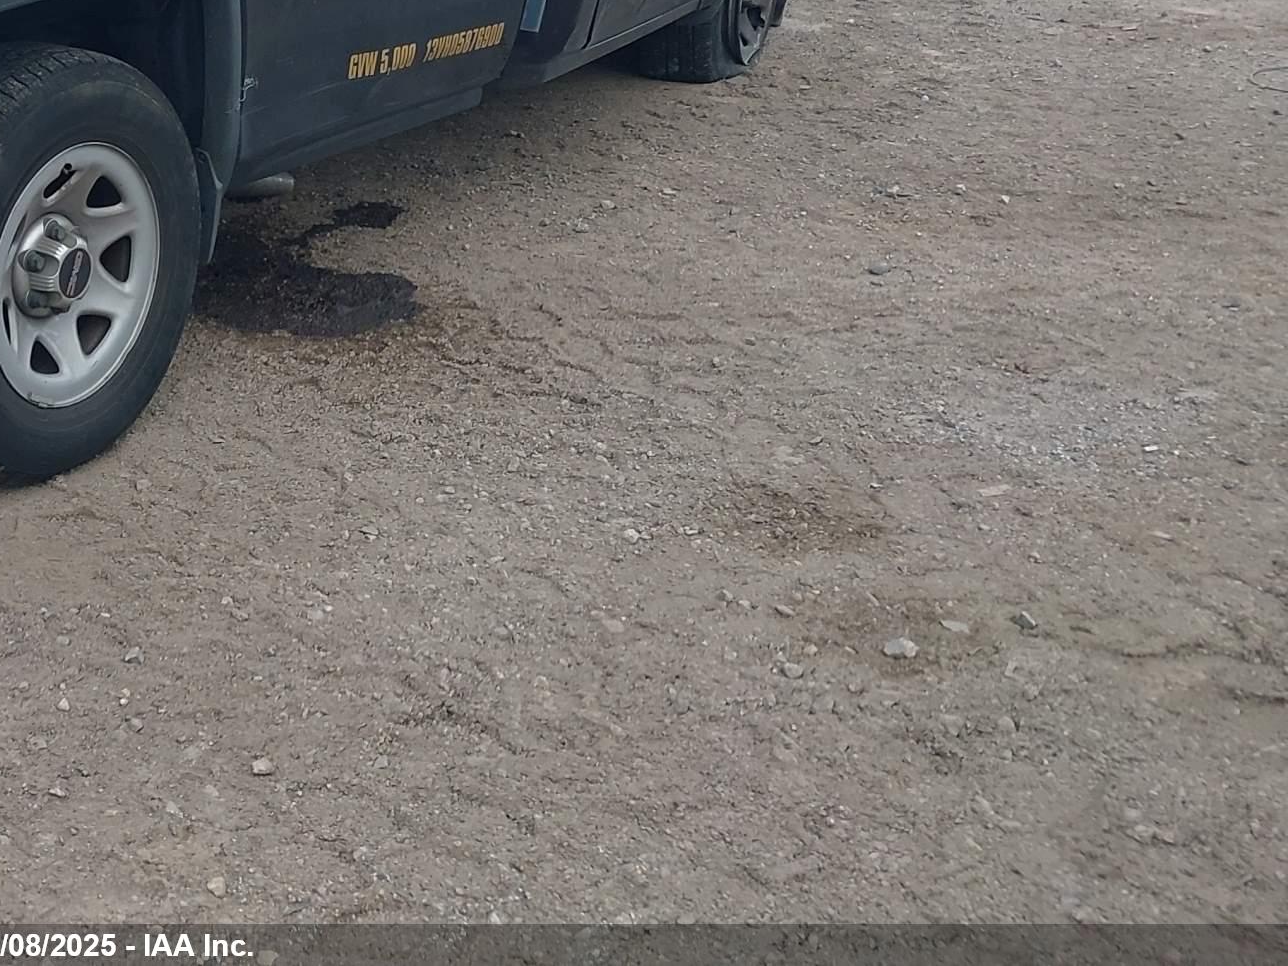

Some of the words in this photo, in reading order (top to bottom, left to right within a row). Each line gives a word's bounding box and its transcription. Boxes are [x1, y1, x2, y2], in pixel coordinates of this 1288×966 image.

[348, 50, 379, 80] GVW
[380, 43, 417, 76] 5,000
[66, 251, 83, 296] GMC
